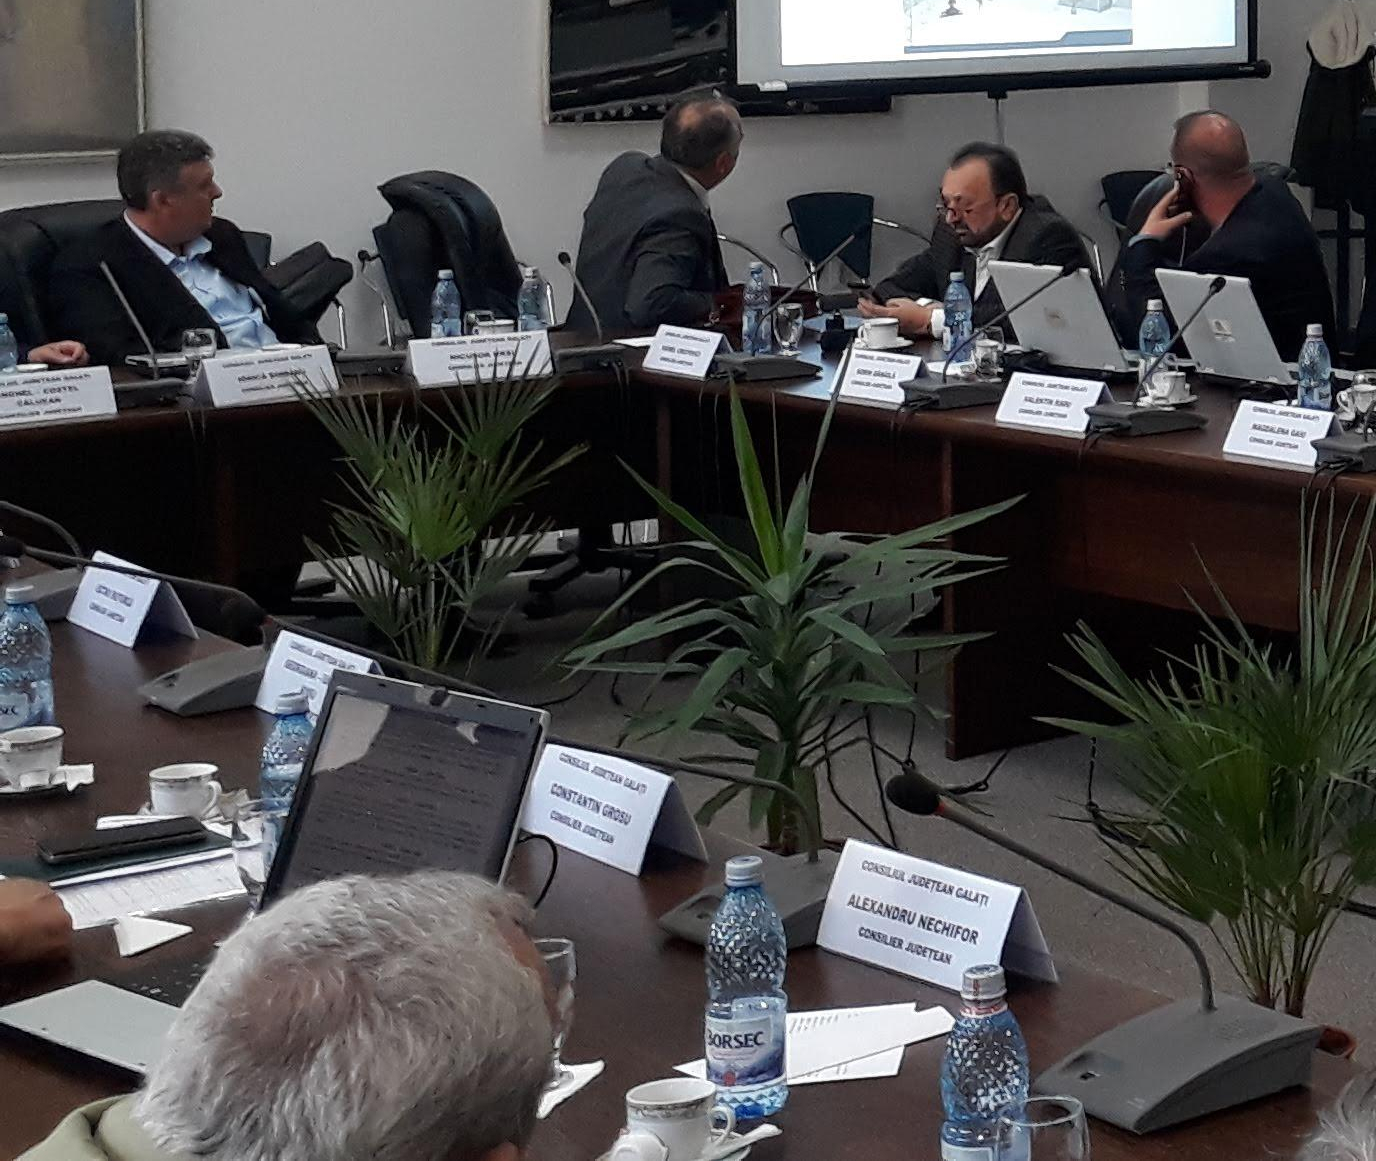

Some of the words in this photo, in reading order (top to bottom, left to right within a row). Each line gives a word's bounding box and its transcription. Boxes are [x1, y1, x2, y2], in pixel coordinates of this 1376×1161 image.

[550, 783, 602, 814] CONSTANTIN
[602, 801, 632, 825] GROSU
[847, 893, 917, 926] ALEXANDRU
[917, 914, 980, 945] NECHIFOR
[858, 926, 905, 951] CONSILIER
[707, 1028, 765, 1049] BORSEC
